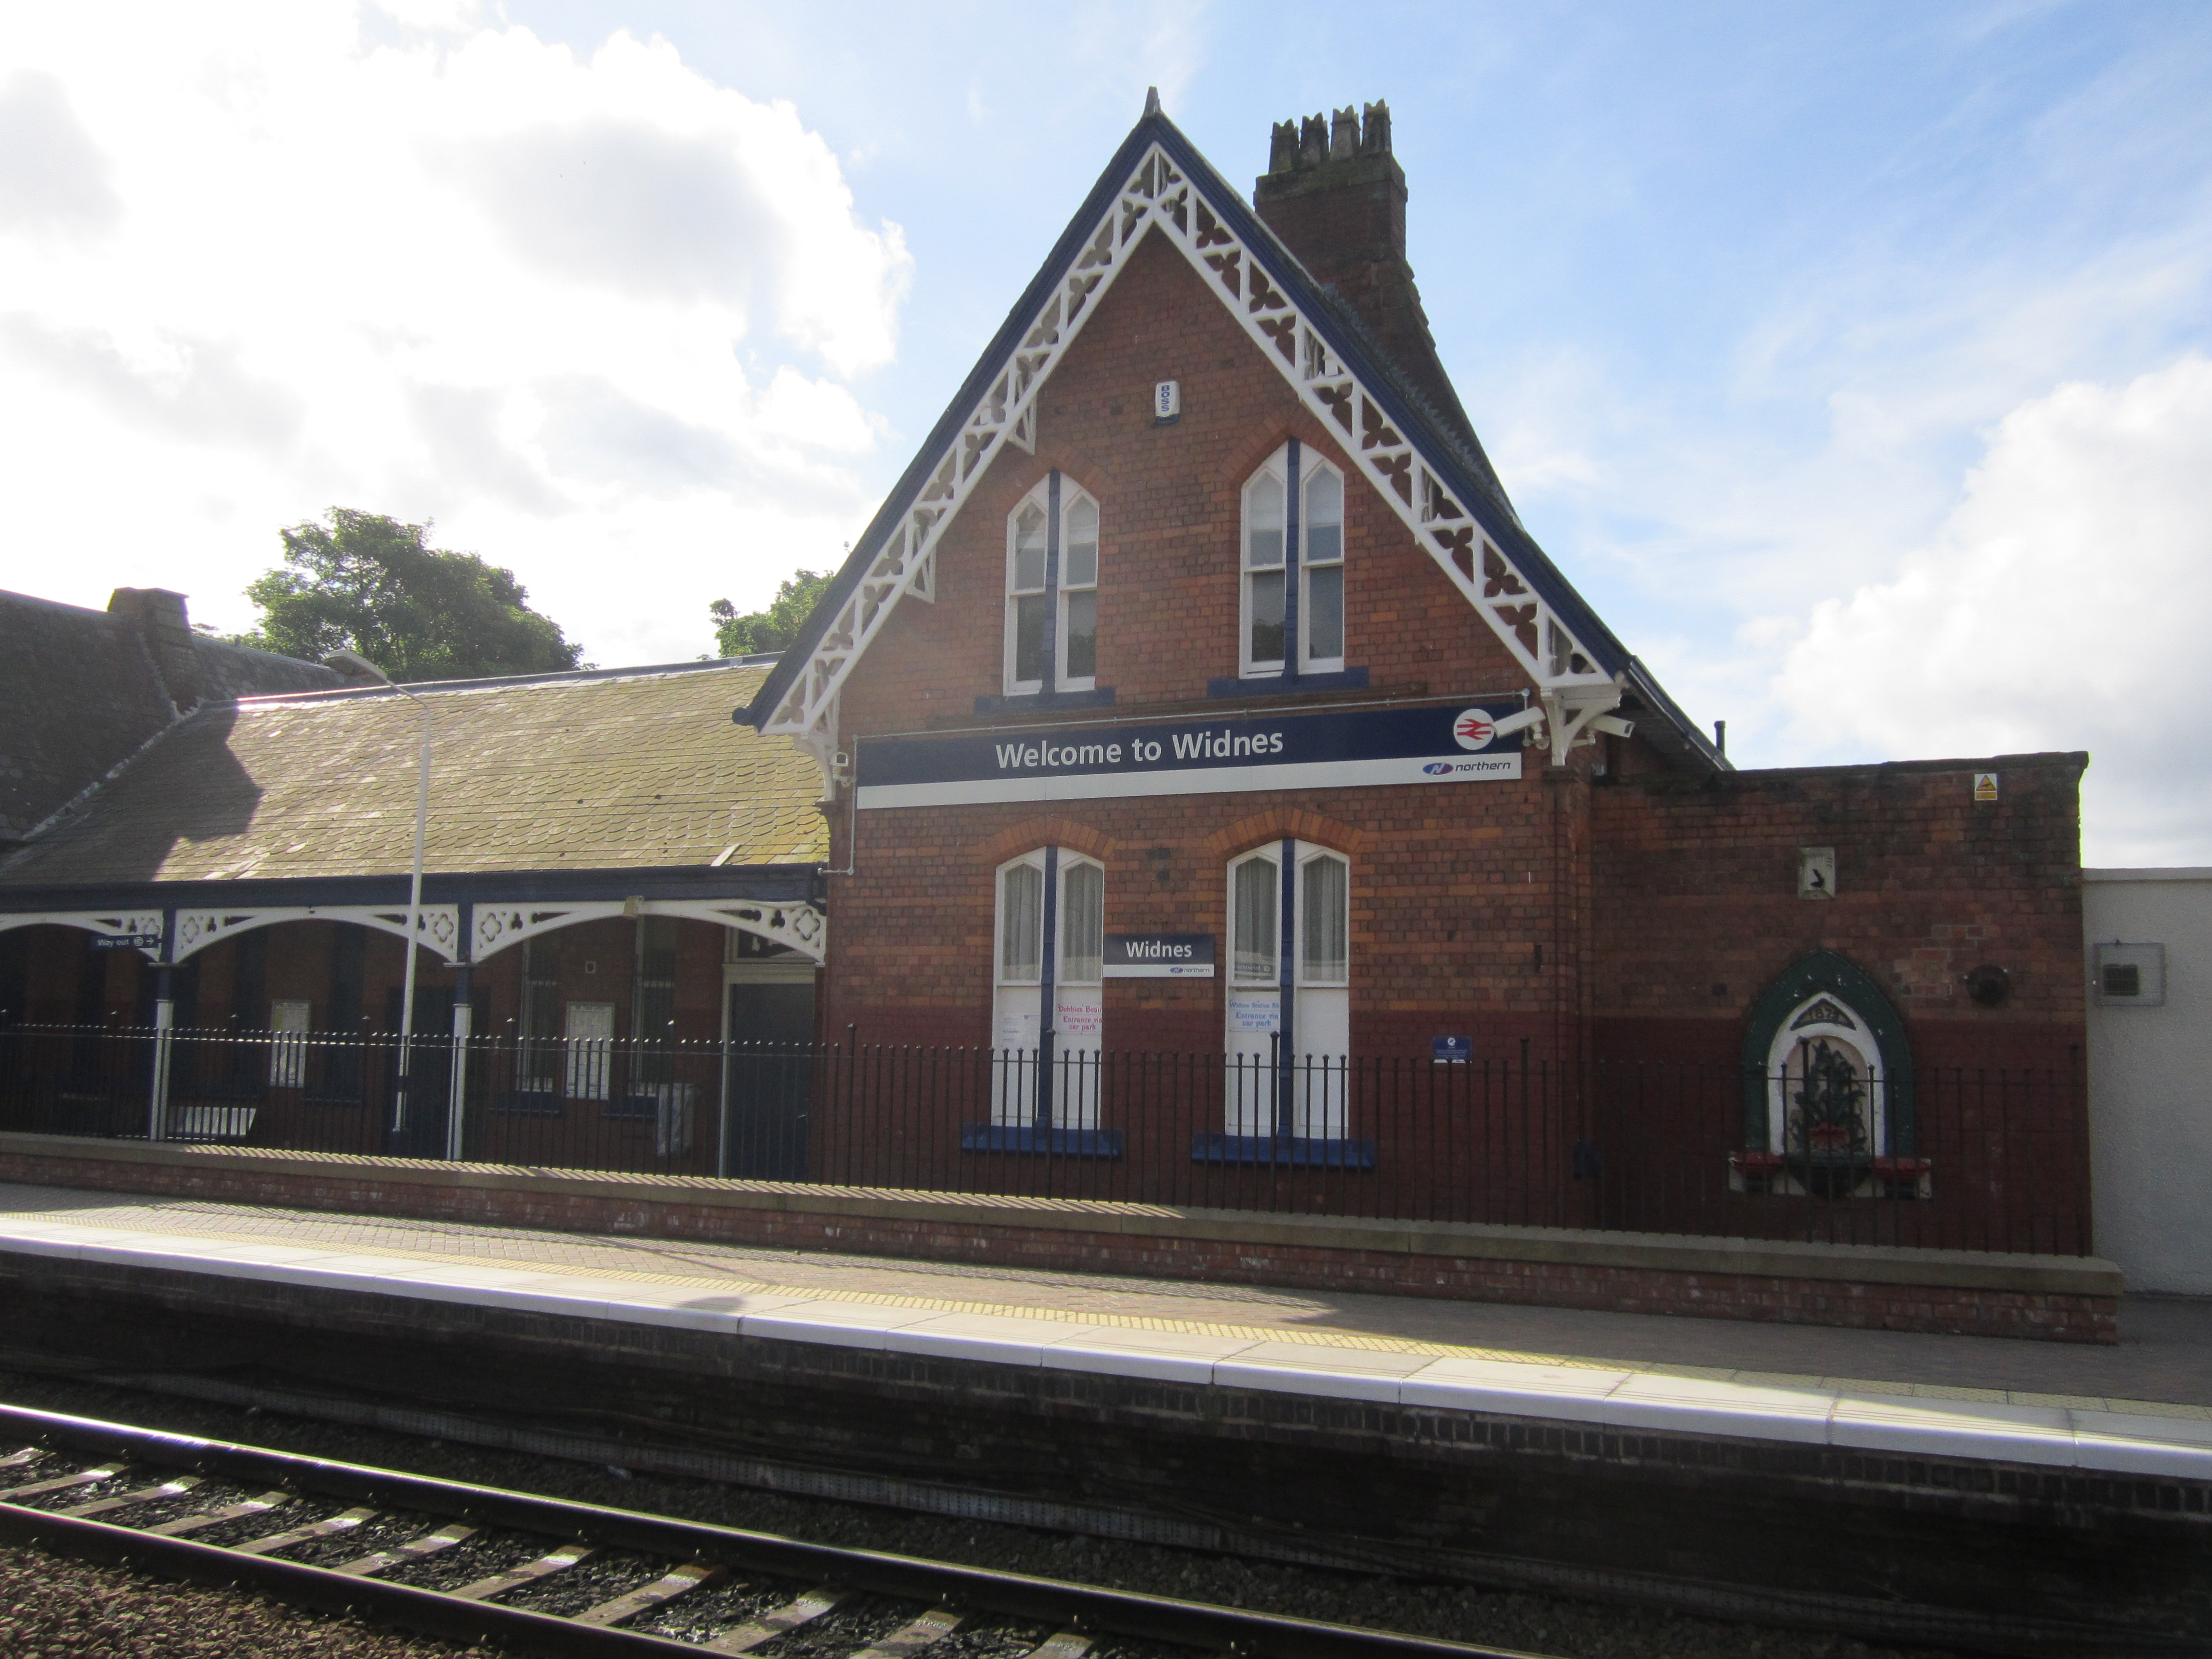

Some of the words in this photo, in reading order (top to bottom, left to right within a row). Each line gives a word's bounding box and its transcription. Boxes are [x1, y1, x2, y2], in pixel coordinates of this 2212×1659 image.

[1161, 385, 1170, 412] BOSS
[995, 740, 1122, 768] Welcome
[1131, 738, 1162, 761] to
[1172, 729, 1284, 759] Widnes
[1455, 761, 1511, 772] northern
[1125, 941, 1192, 958] Widnes
[1081, 1024, 1096, 1032] park
[1256, 1019, 1271, 1028] park
